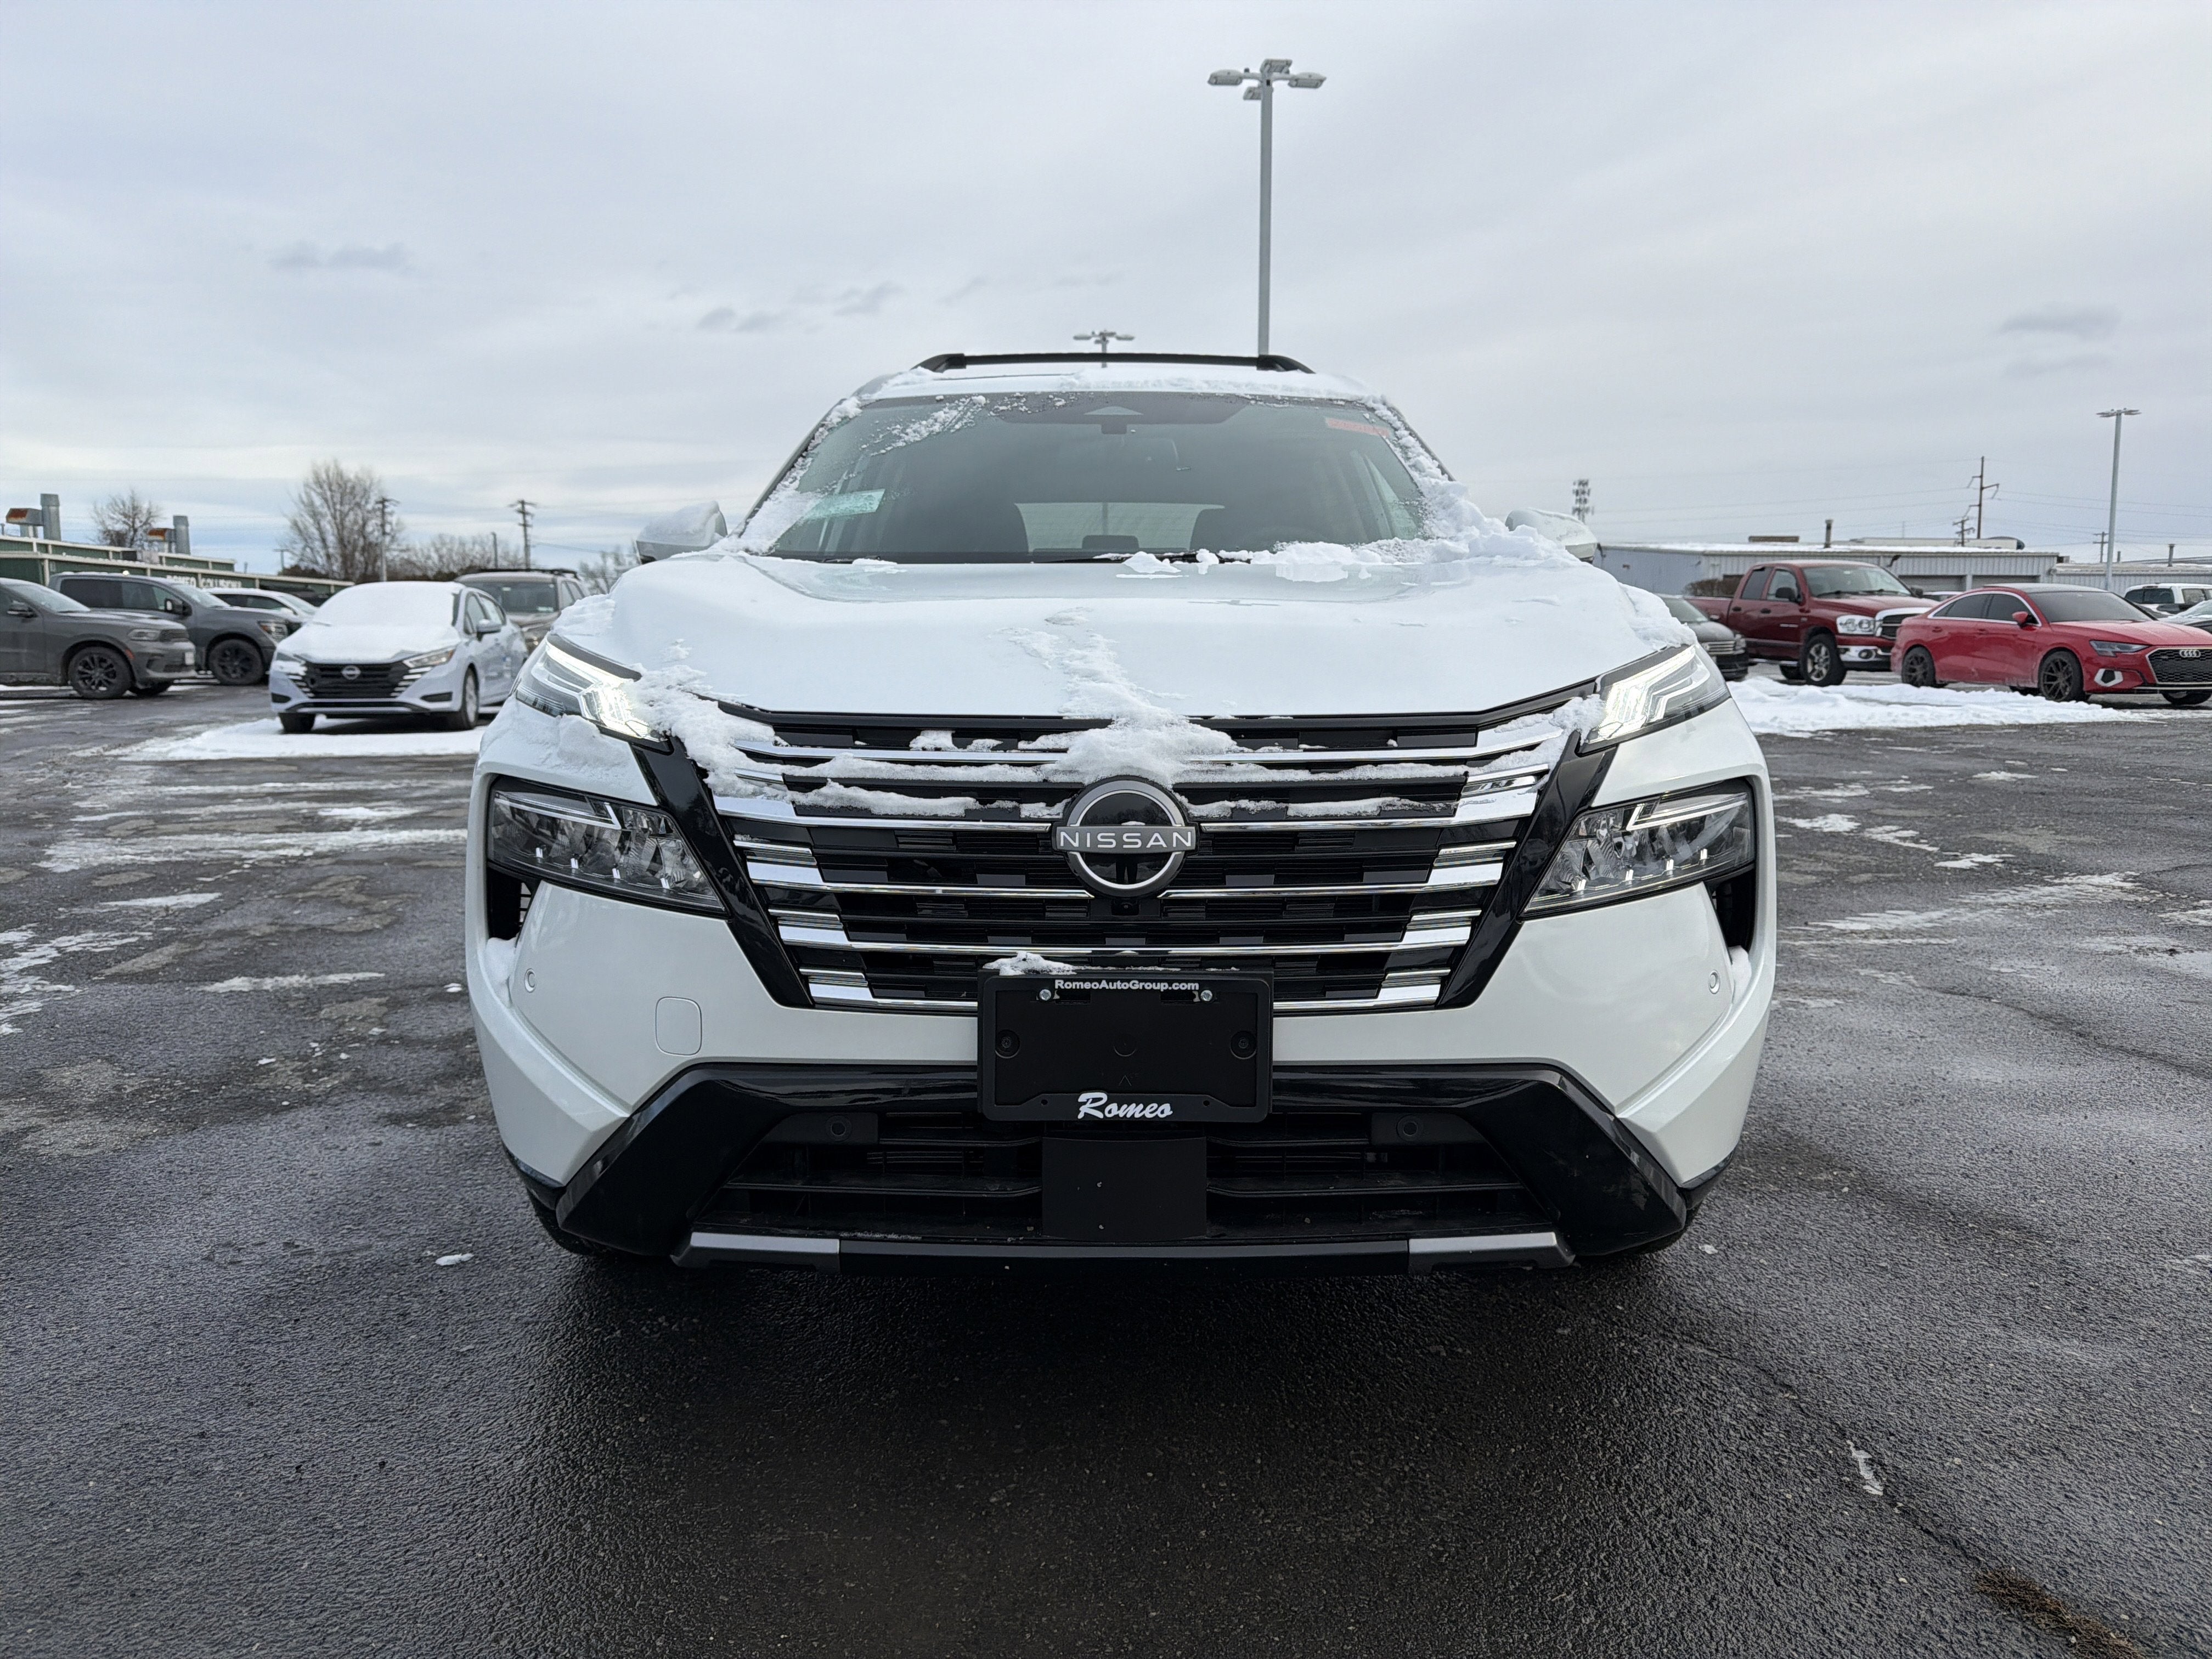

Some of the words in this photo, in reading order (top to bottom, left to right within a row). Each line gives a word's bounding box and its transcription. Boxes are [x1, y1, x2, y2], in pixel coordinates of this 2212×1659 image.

[1060, 831, 1192, 848] NISSAN
[1055, 979, 1199, 991] RomeoAutoGroup.com
[1077, 1092, 1173, 1119] Romeo
